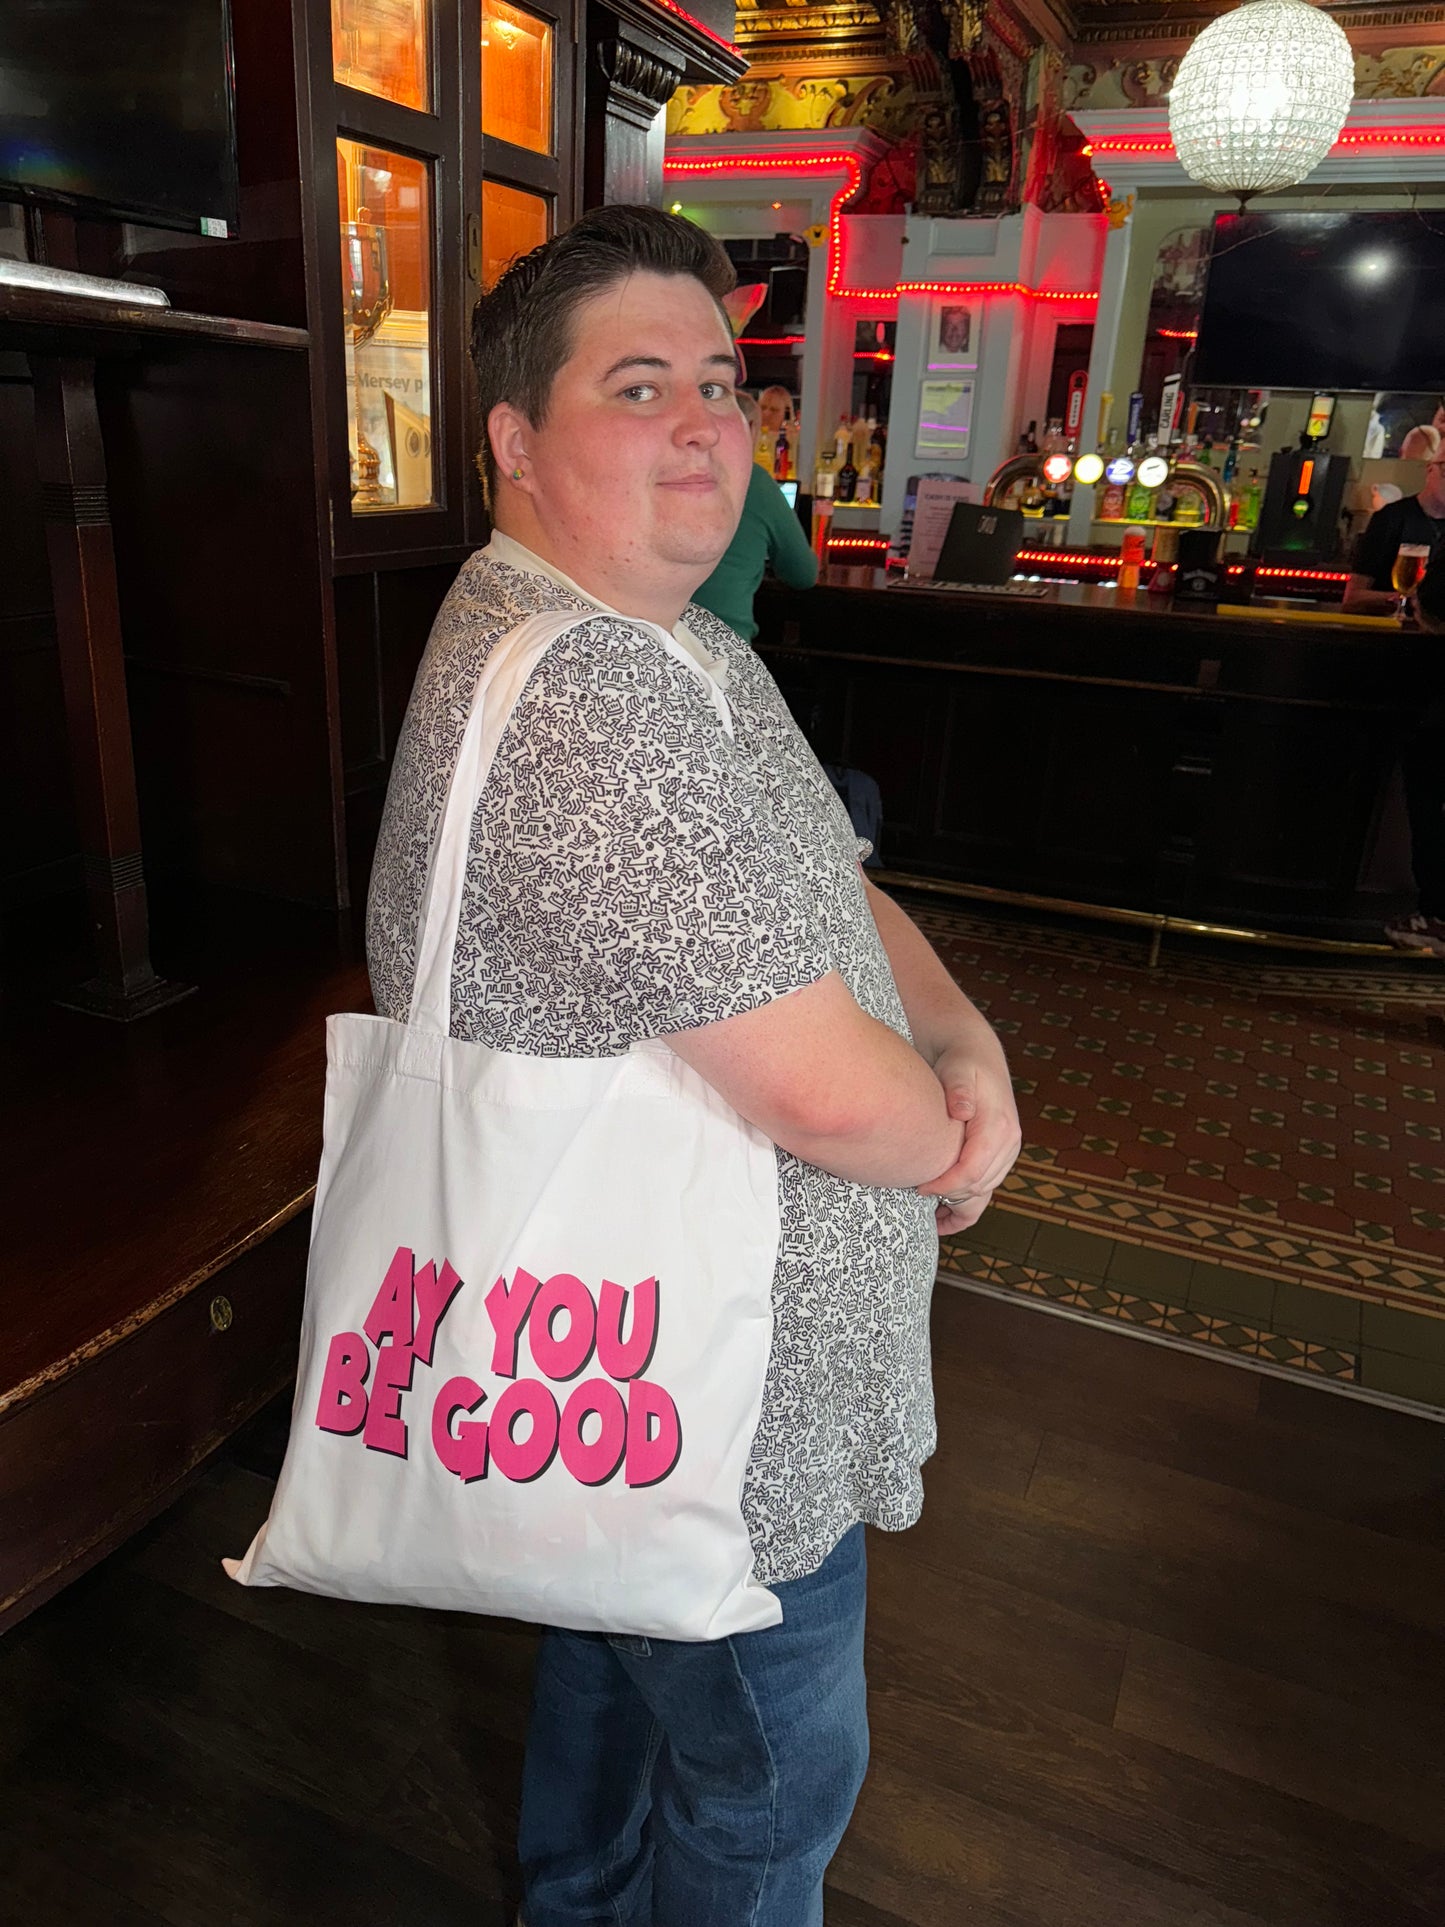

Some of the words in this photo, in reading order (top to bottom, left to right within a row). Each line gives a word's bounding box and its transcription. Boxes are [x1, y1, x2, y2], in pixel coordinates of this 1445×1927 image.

[357, 373, 411, 392] Mersey
[1159, 392, 1175, 429] CARLING
[363, 1246, 464, 1367] AY
[484, 1266, 659, 1382] YOU
[315, 1331, 412, 1460] BE
[431, 1376, 682, 1488] GOOD
